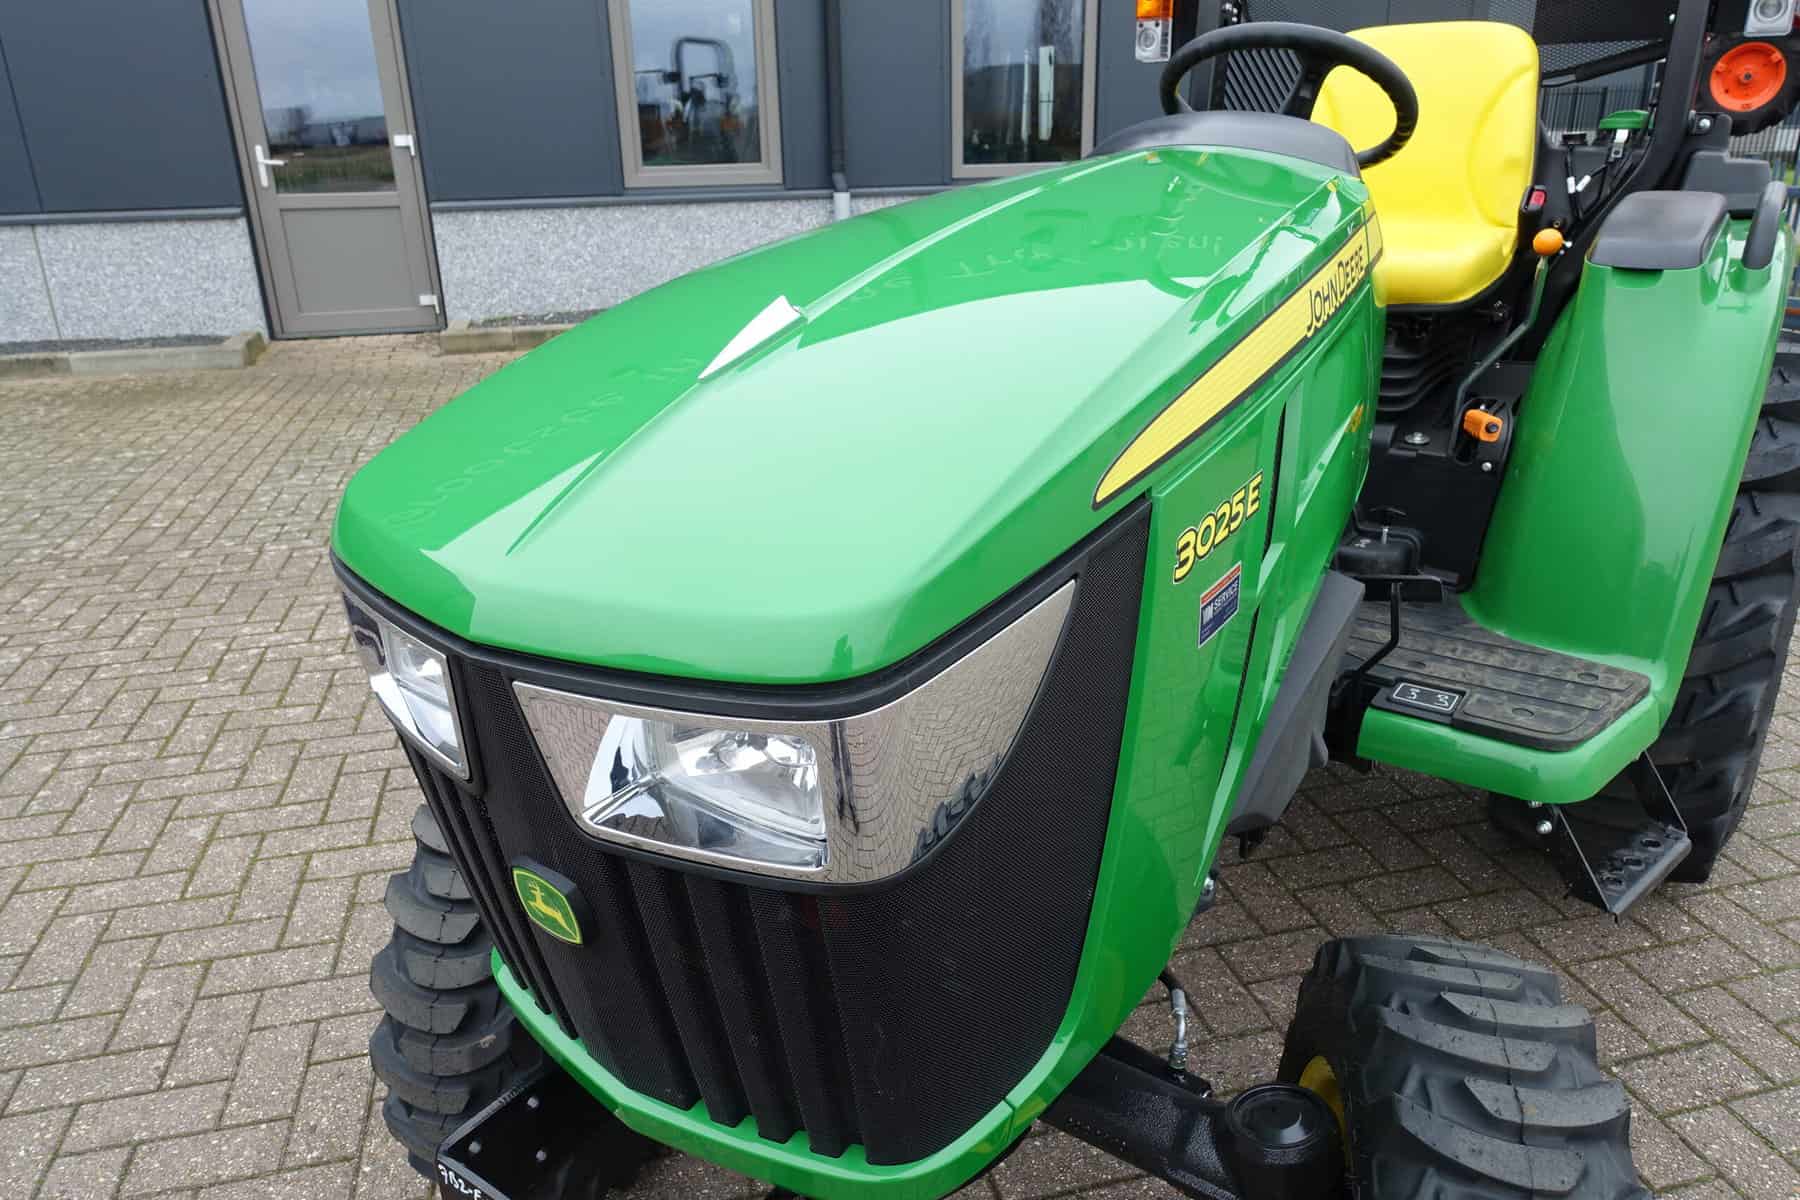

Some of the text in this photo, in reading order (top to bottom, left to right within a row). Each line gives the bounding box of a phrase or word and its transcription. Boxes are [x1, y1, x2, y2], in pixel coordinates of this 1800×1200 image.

[1307, 244, 1364, 334] JOHN DEERE
[1173, 470, 1263, 583] 3025E
[1214, 579, 1239, 611] SERVICE
